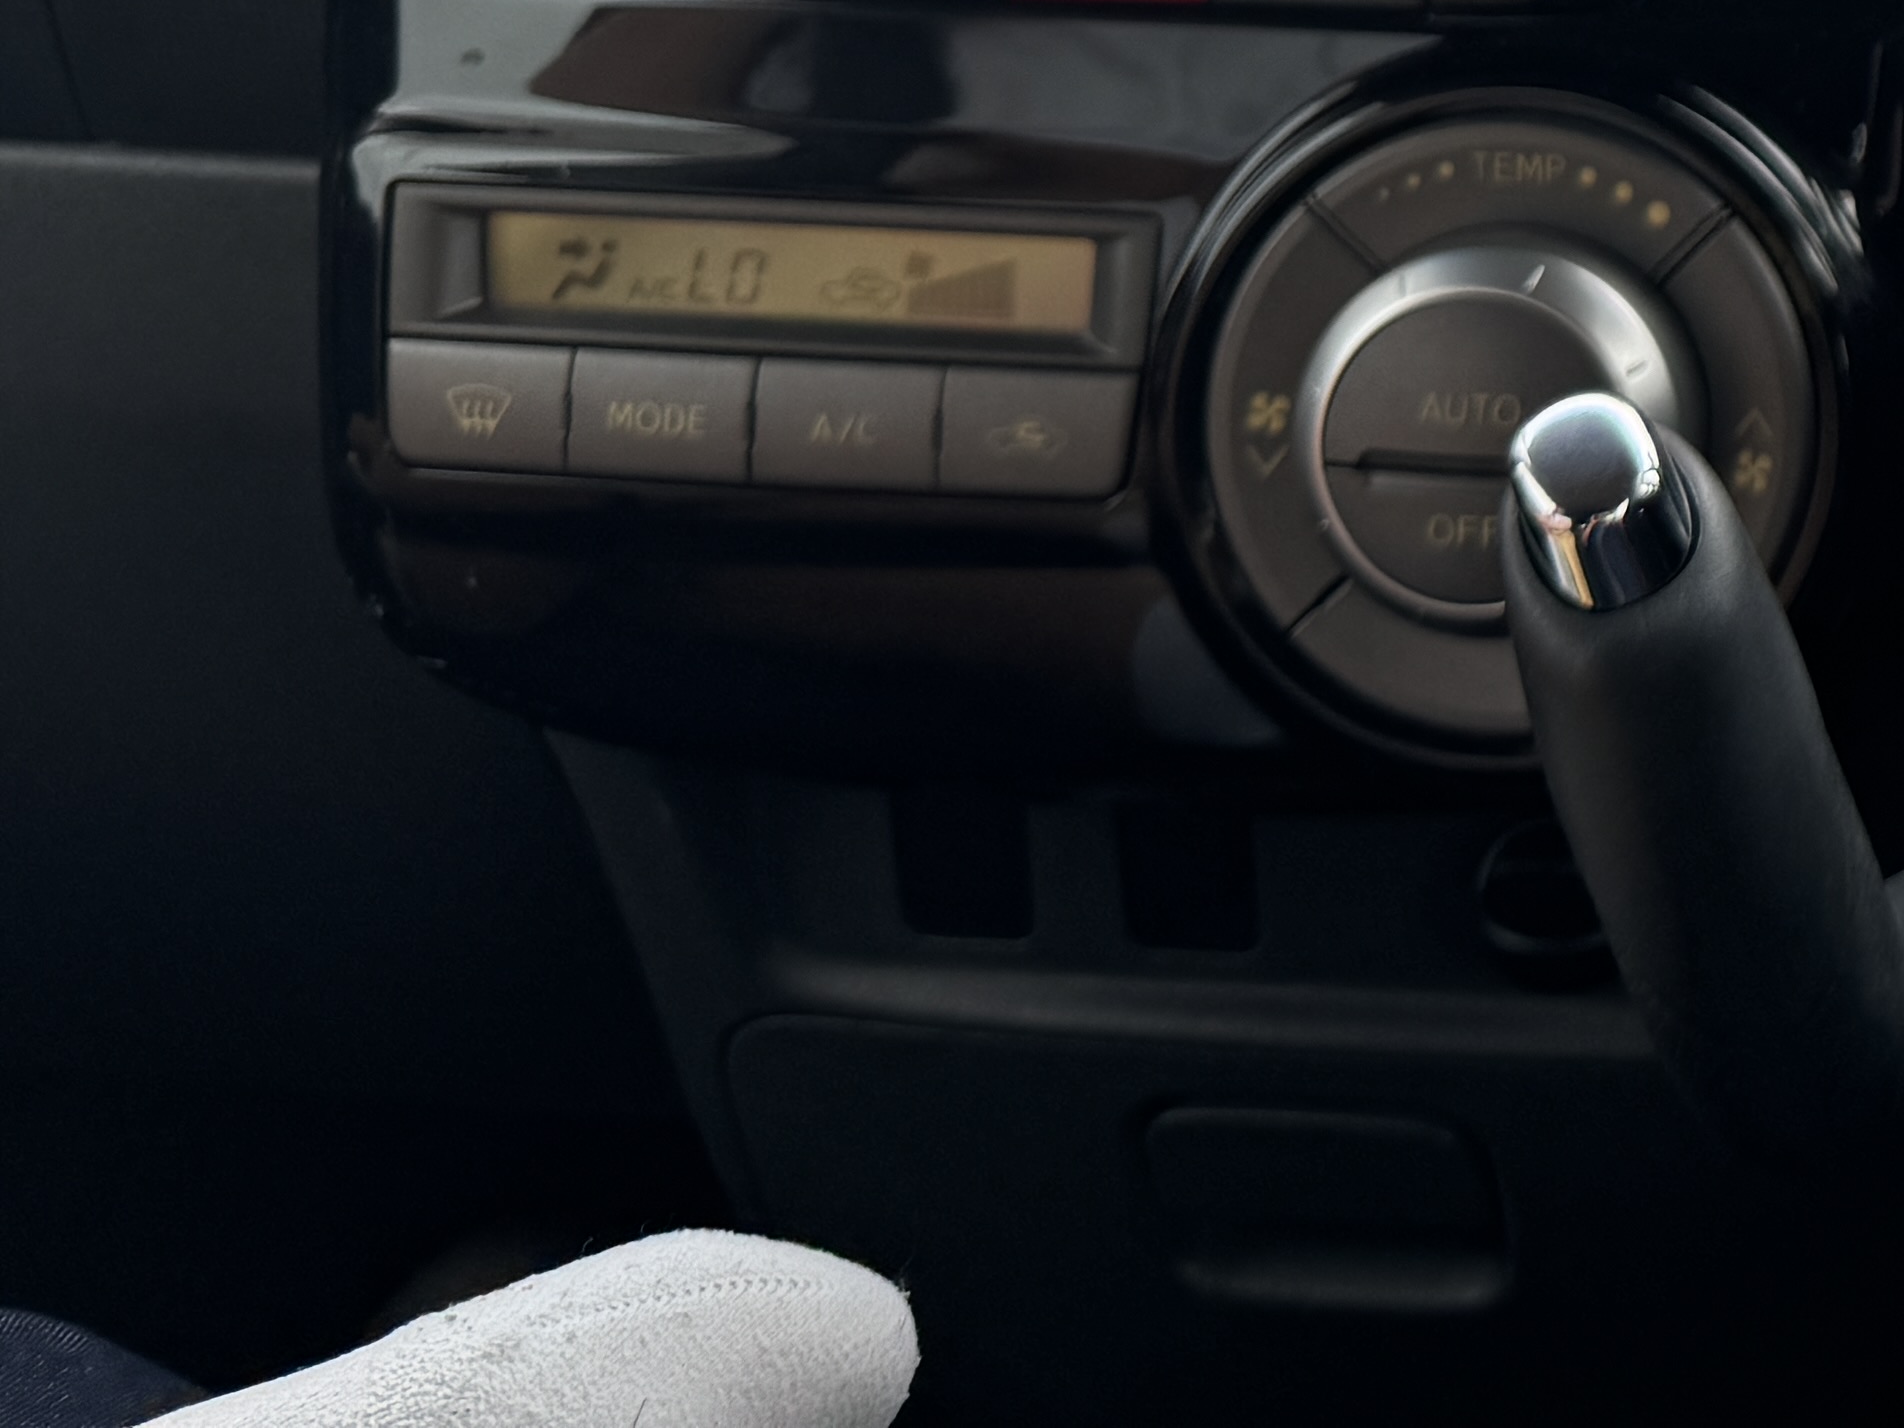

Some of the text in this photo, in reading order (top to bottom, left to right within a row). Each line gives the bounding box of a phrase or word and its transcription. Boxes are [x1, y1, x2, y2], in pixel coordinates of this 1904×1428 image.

[1472, 151, 1567, 184] TEMP
[608, 399, 707, 437] MODE
[1418, 390, 1523, 429] AUTO
[809, 410, 880, 447] A/C
[1426, 513, 1502, 550] OFF
